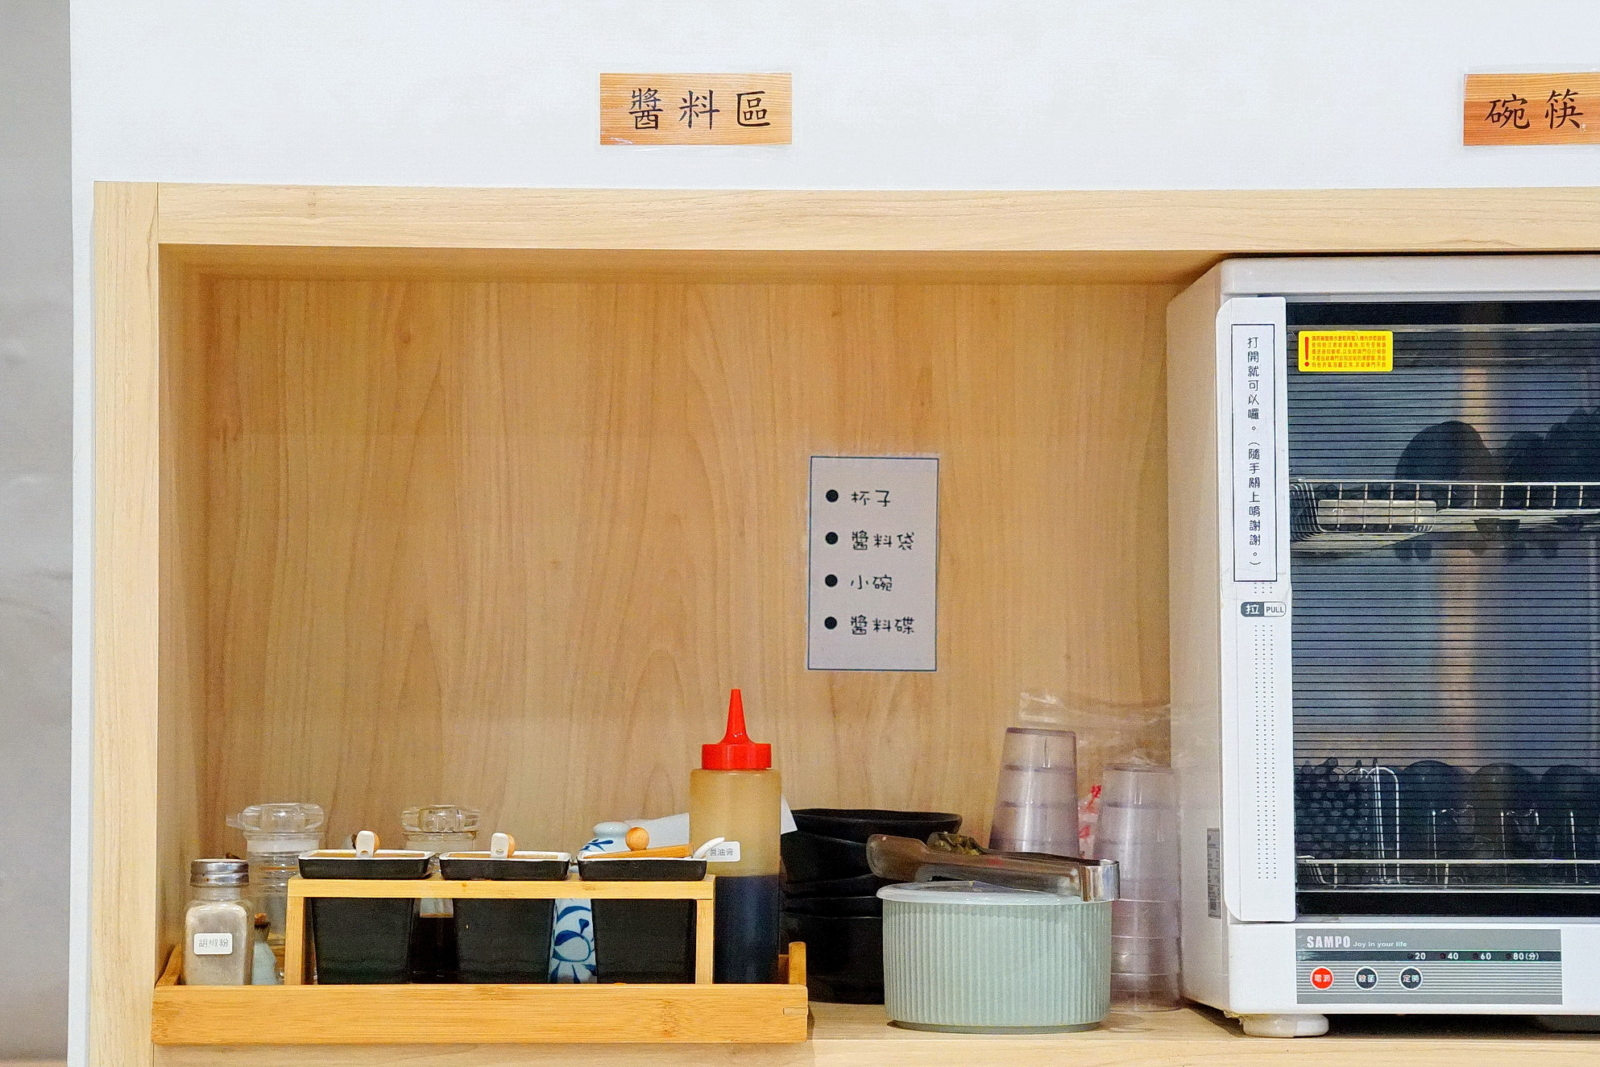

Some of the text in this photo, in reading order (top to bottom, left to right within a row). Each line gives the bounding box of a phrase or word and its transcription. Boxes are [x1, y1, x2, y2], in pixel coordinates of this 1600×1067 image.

[629, 87, 771, 130] 醬料區
[1484, 88, 1584, 129] 碗筷
[851, 489, 891, 507] 杯子
[851, 530, 915, 551] 醬料袋
[850, 574, 893, 592] 小碗
[1245, 603, 1260, 615] 拉
[850, 614, 915, 635] 醬料碟
[1306, 935, 1351, 948] SAMPO
[1414, 952, 1427, 960] 20
[1447, 952, 1459, 960] 40
[1480, 952, 1492, 960] 60
